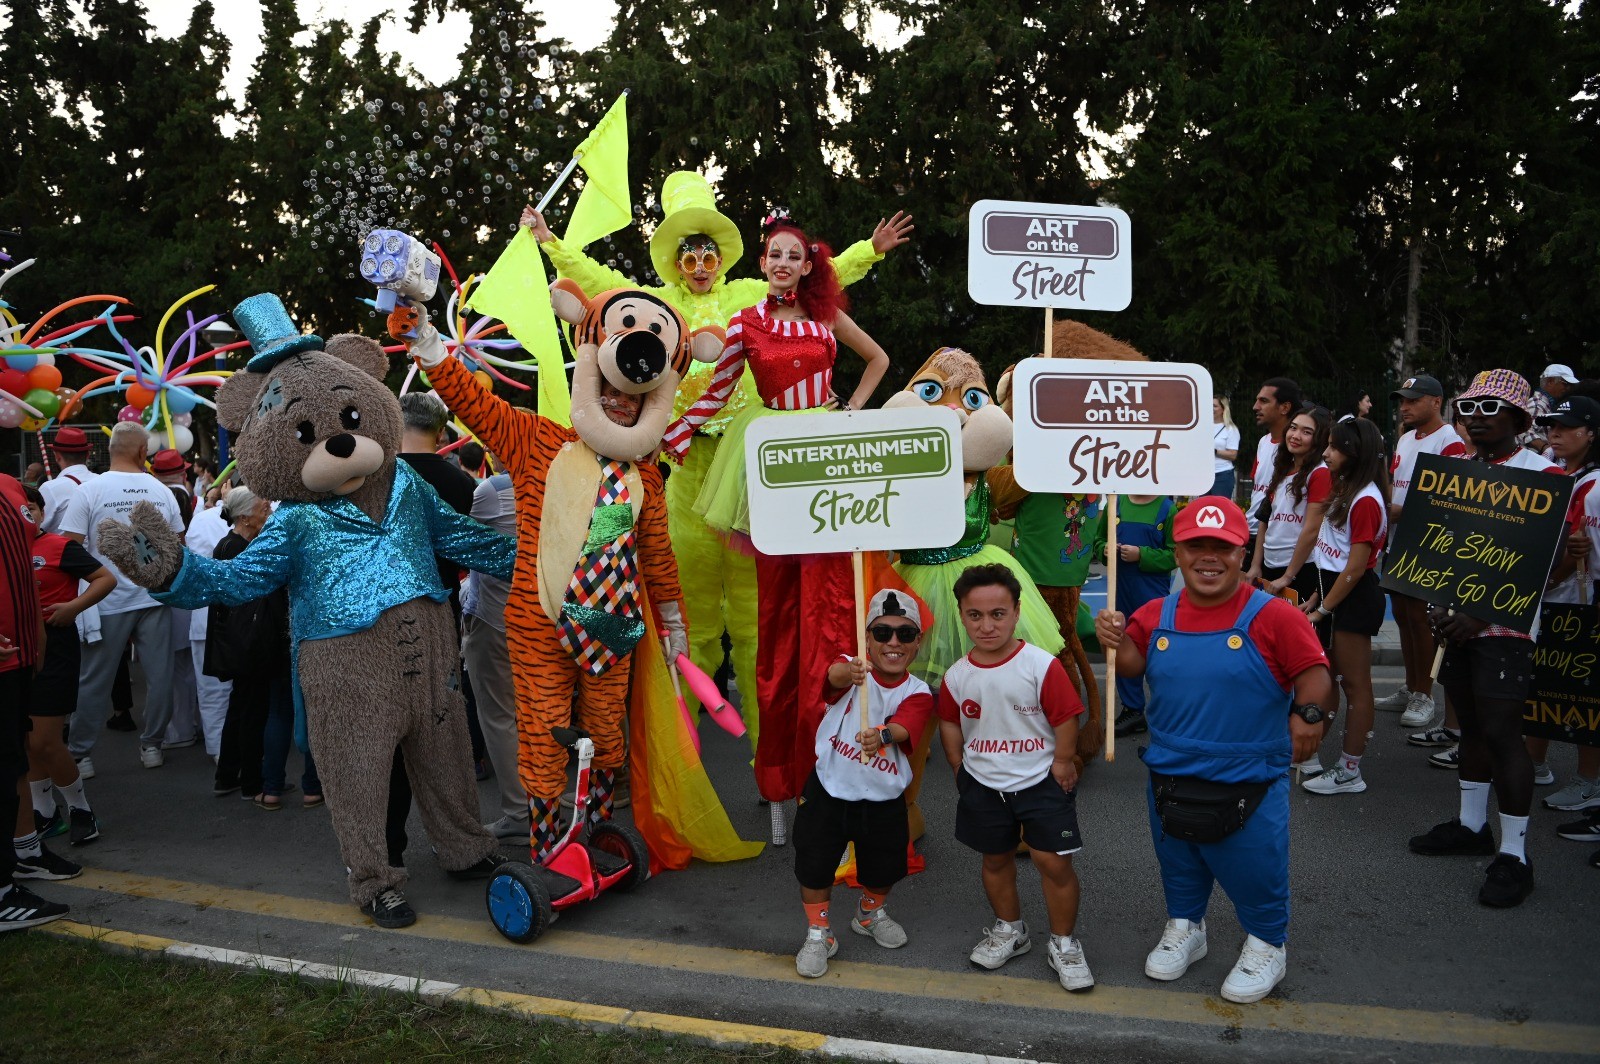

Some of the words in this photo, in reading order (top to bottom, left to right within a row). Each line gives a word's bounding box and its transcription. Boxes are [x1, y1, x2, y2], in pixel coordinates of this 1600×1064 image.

[1026, 219, 1079, 238] ART
[1026, 239, 1048, 251] on
[1051, 239, 1079, 252] the
[1012, 258, 1095, 301] Street
[1084, 381, 1148, 404] ART
[1085, 408, 1111, 422] on
[1115, 405, 1149, 422] the
[765, 437, 943, 466] ENTERTAINMENT
[1069, 429, 1170, 486] Street
[825, 463, 849, 477] on
[852, 460, 883, 475] the
[809, 480, 900, 534] Street
[1198, 509, 1222, 525] M
[1273, 512, 1304, 524] ATION
[1430, 498, 1488, 516] ENTERTAINMENT
[1488, 509, 1495, 518] &
[1495, 512, 1526, 525] EVENTS
[1420, 523, 1453, 553] The
[1456, 534, 1523, 573] Show
[1388, 550, 1454, 590] Must
[1456, 574, 1486, 605] Go
[1493, 584, 1537, 616] On!
[828, 734, 898, 775] ANIMAION
[968, 737, 1045, 753] ANIMATION
